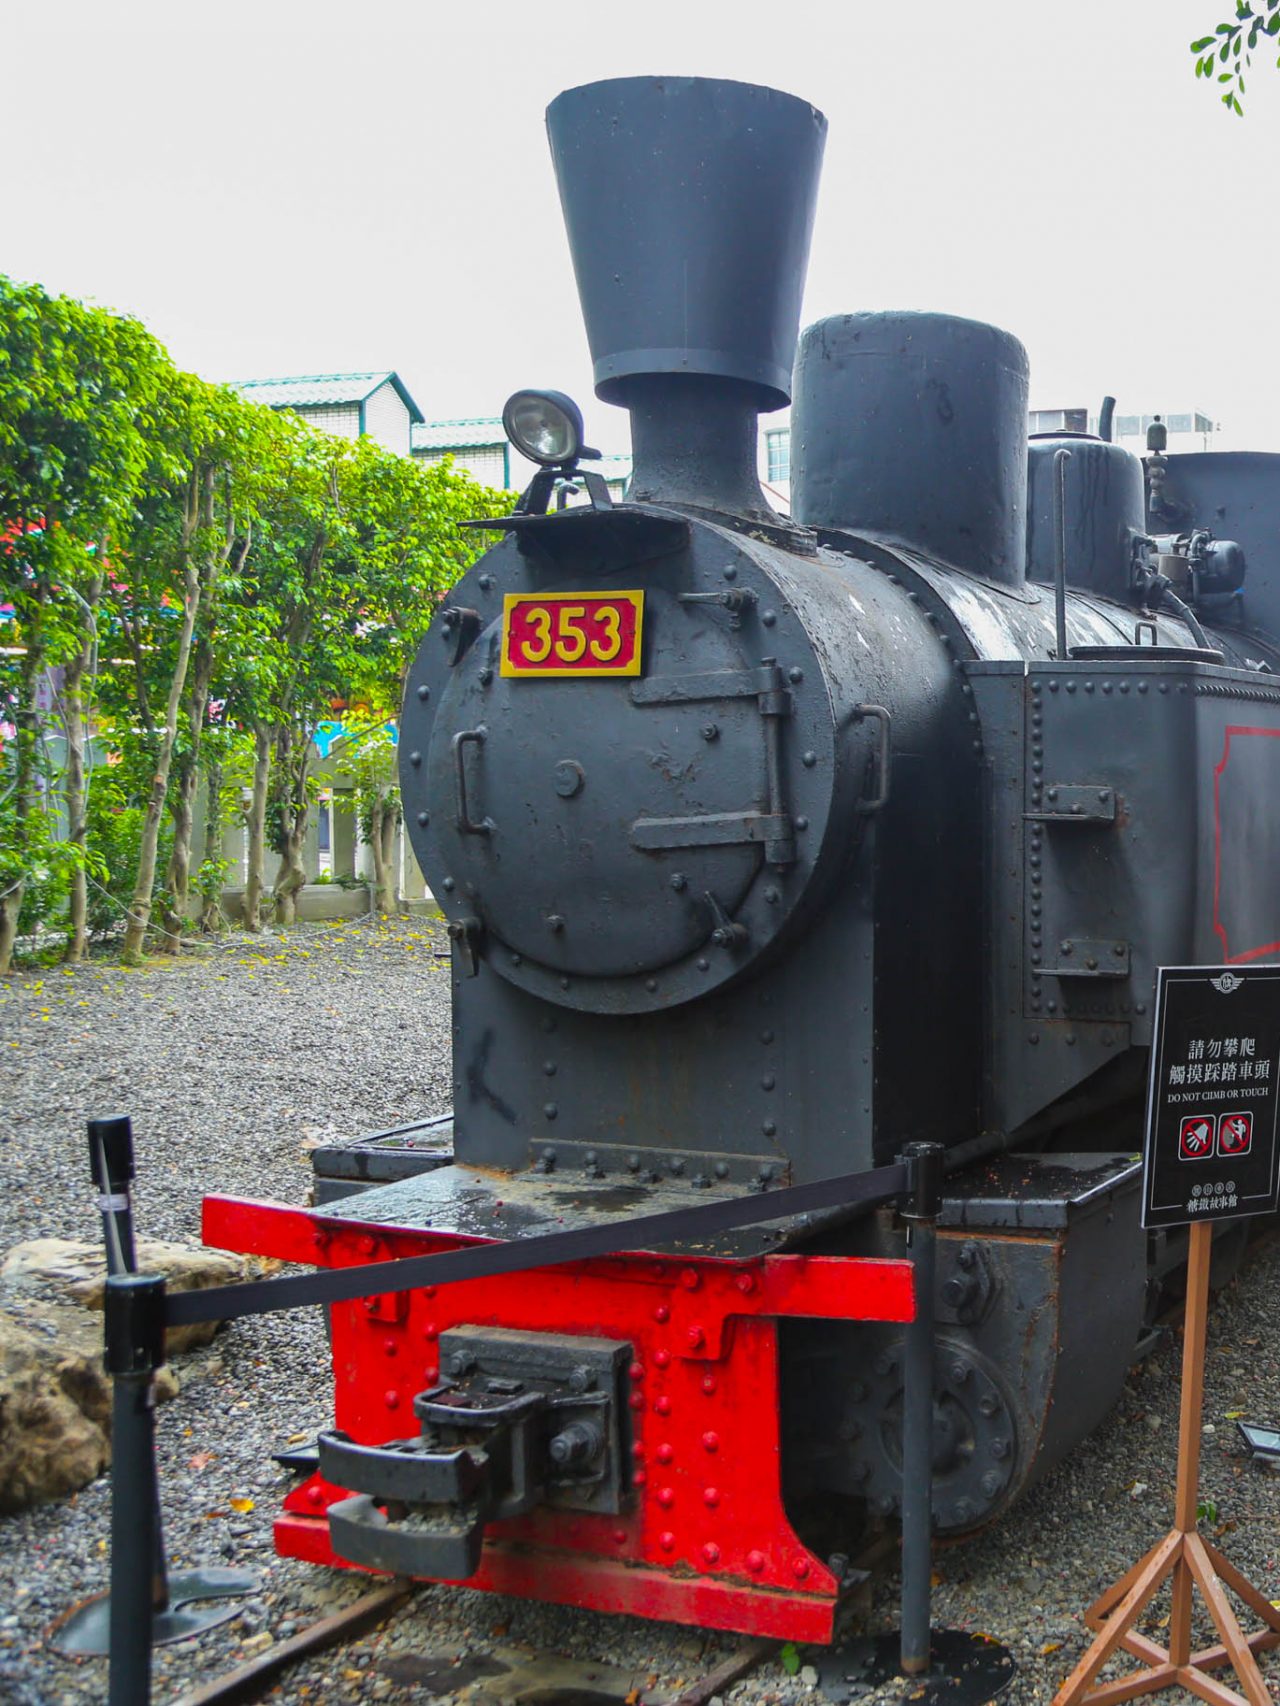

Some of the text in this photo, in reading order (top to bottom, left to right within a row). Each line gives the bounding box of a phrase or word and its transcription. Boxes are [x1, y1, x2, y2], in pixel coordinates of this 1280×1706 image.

[521, 606, 621, 662] 353
[1188, 1037, 1256, 1060] 請勿攀爬
[1169, 1059, 1271, 1085] 觸摸踩踏車頭
[1167, 1094, 1181, 1103] DO
[1182, 1092, 1201, 1103] NOT
[1226, 1089, 1239, 1099] OR
[1240, 1087, 1269, 1098] TOUCH
